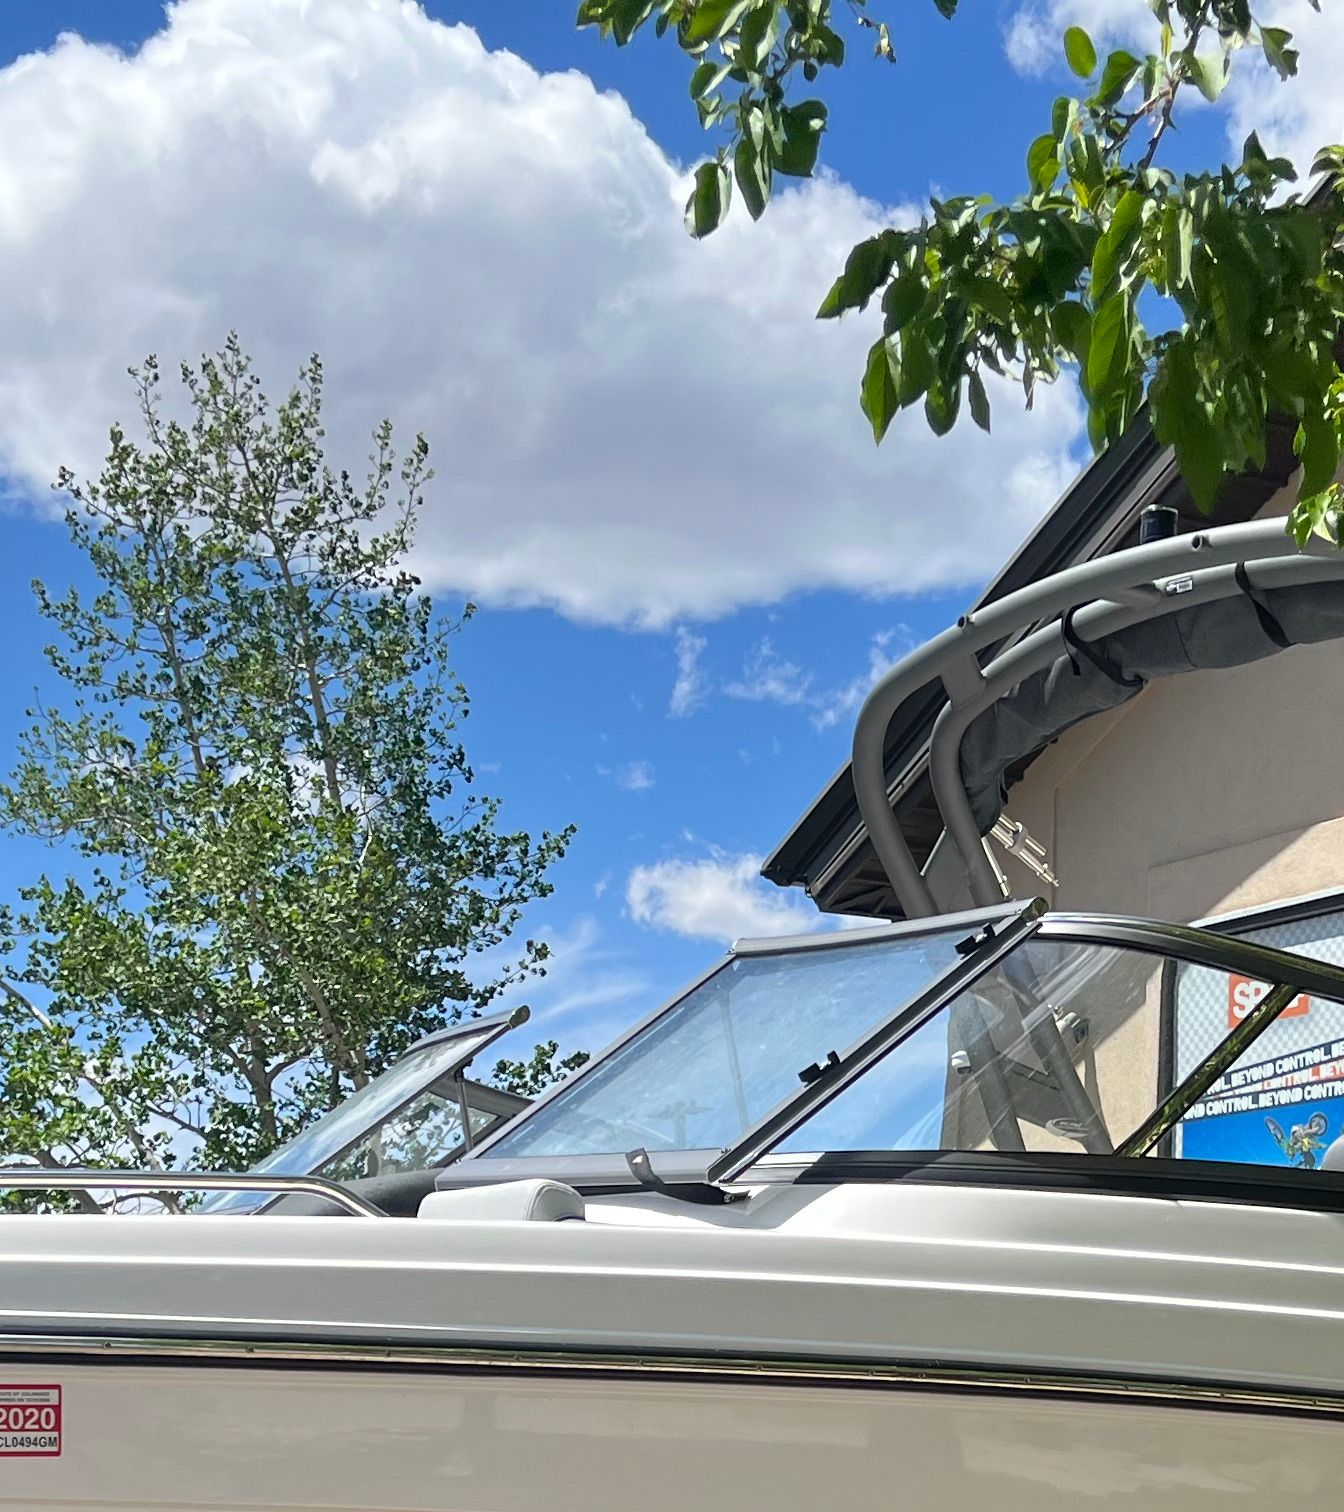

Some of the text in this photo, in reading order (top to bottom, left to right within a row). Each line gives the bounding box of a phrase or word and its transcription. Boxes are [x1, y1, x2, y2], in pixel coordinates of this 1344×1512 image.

[1231, 1063, 1275, 1087] BEYOND
[1275, 1047, 1331, 1074] CONTROL.
[1205, 1095, 1258, 1116] CONTROL.
[1258, 1087, 1303, 1108] BEYOND
